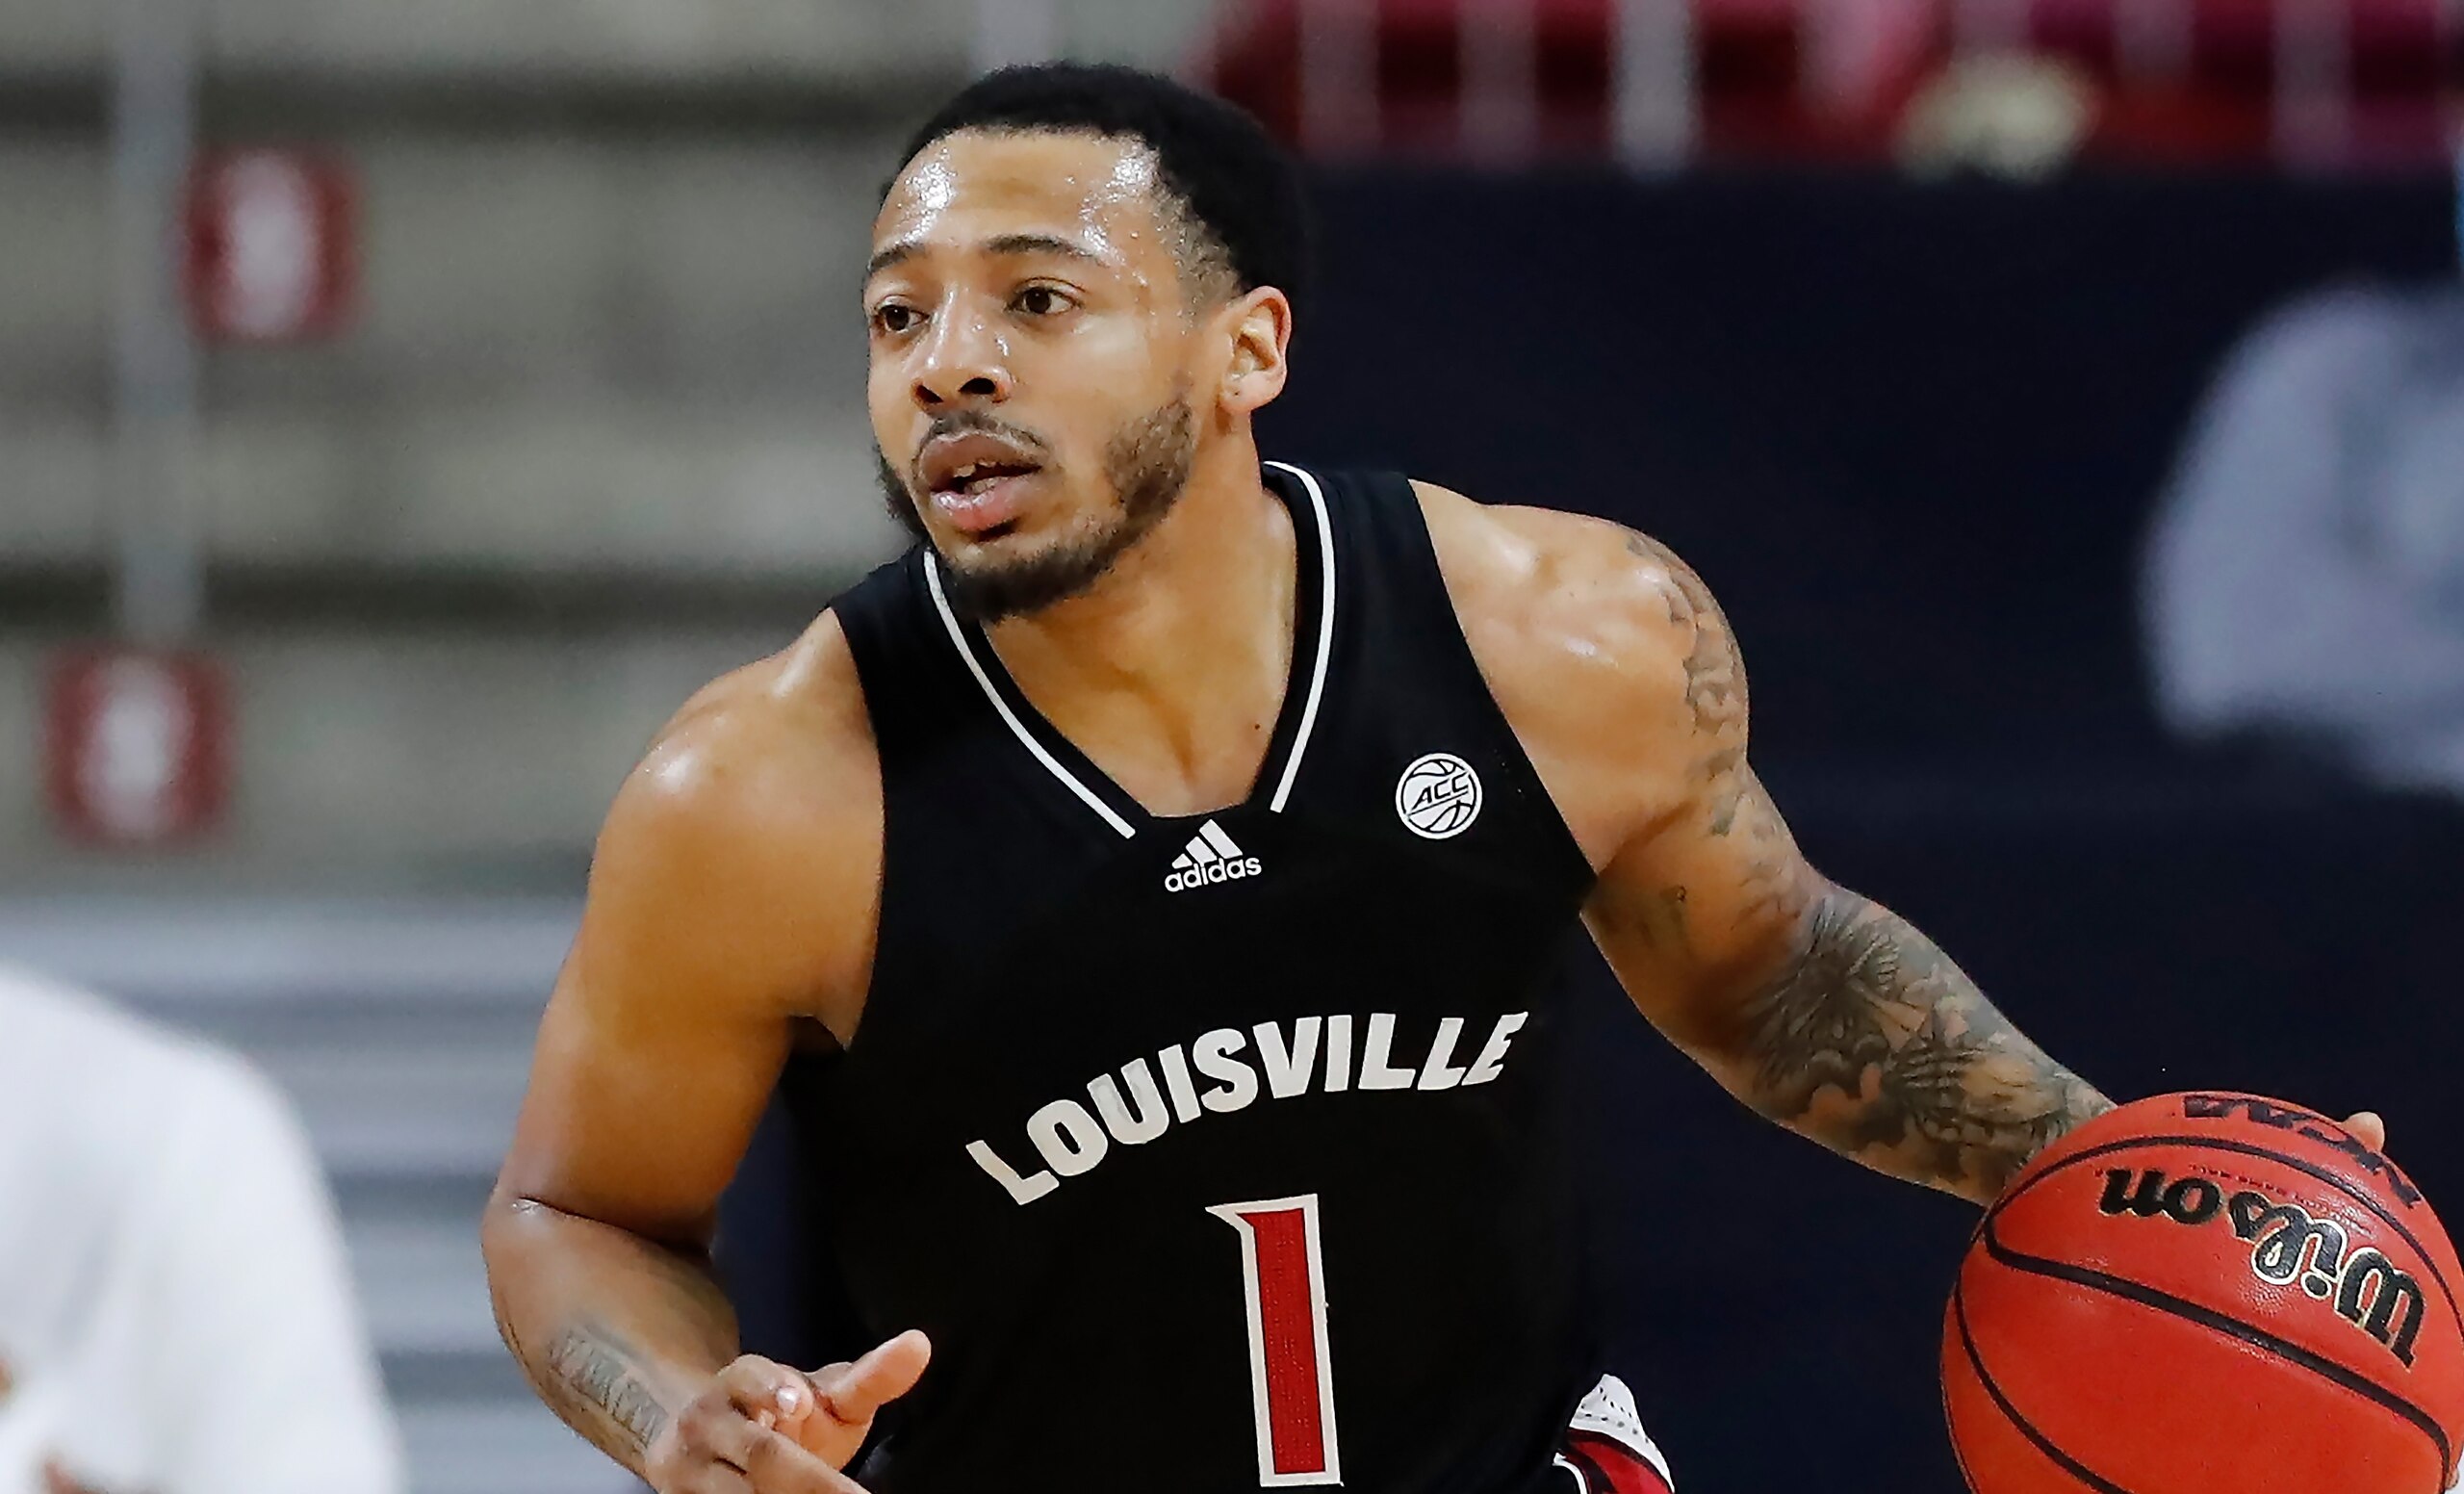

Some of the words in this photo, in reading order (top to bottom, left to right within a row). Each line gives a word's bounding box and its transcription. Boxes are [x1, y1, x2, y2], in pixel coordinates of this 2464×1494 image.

[1164, 857, 1263, 892] adidas
[1412, 770, 1471, 811] ACC
[965, 1012, 1528, 1205] LOUISVILLE
[1205, 1194, 1343, 1487] 1
[2098, 1167, 2426, 1372] Wilson
